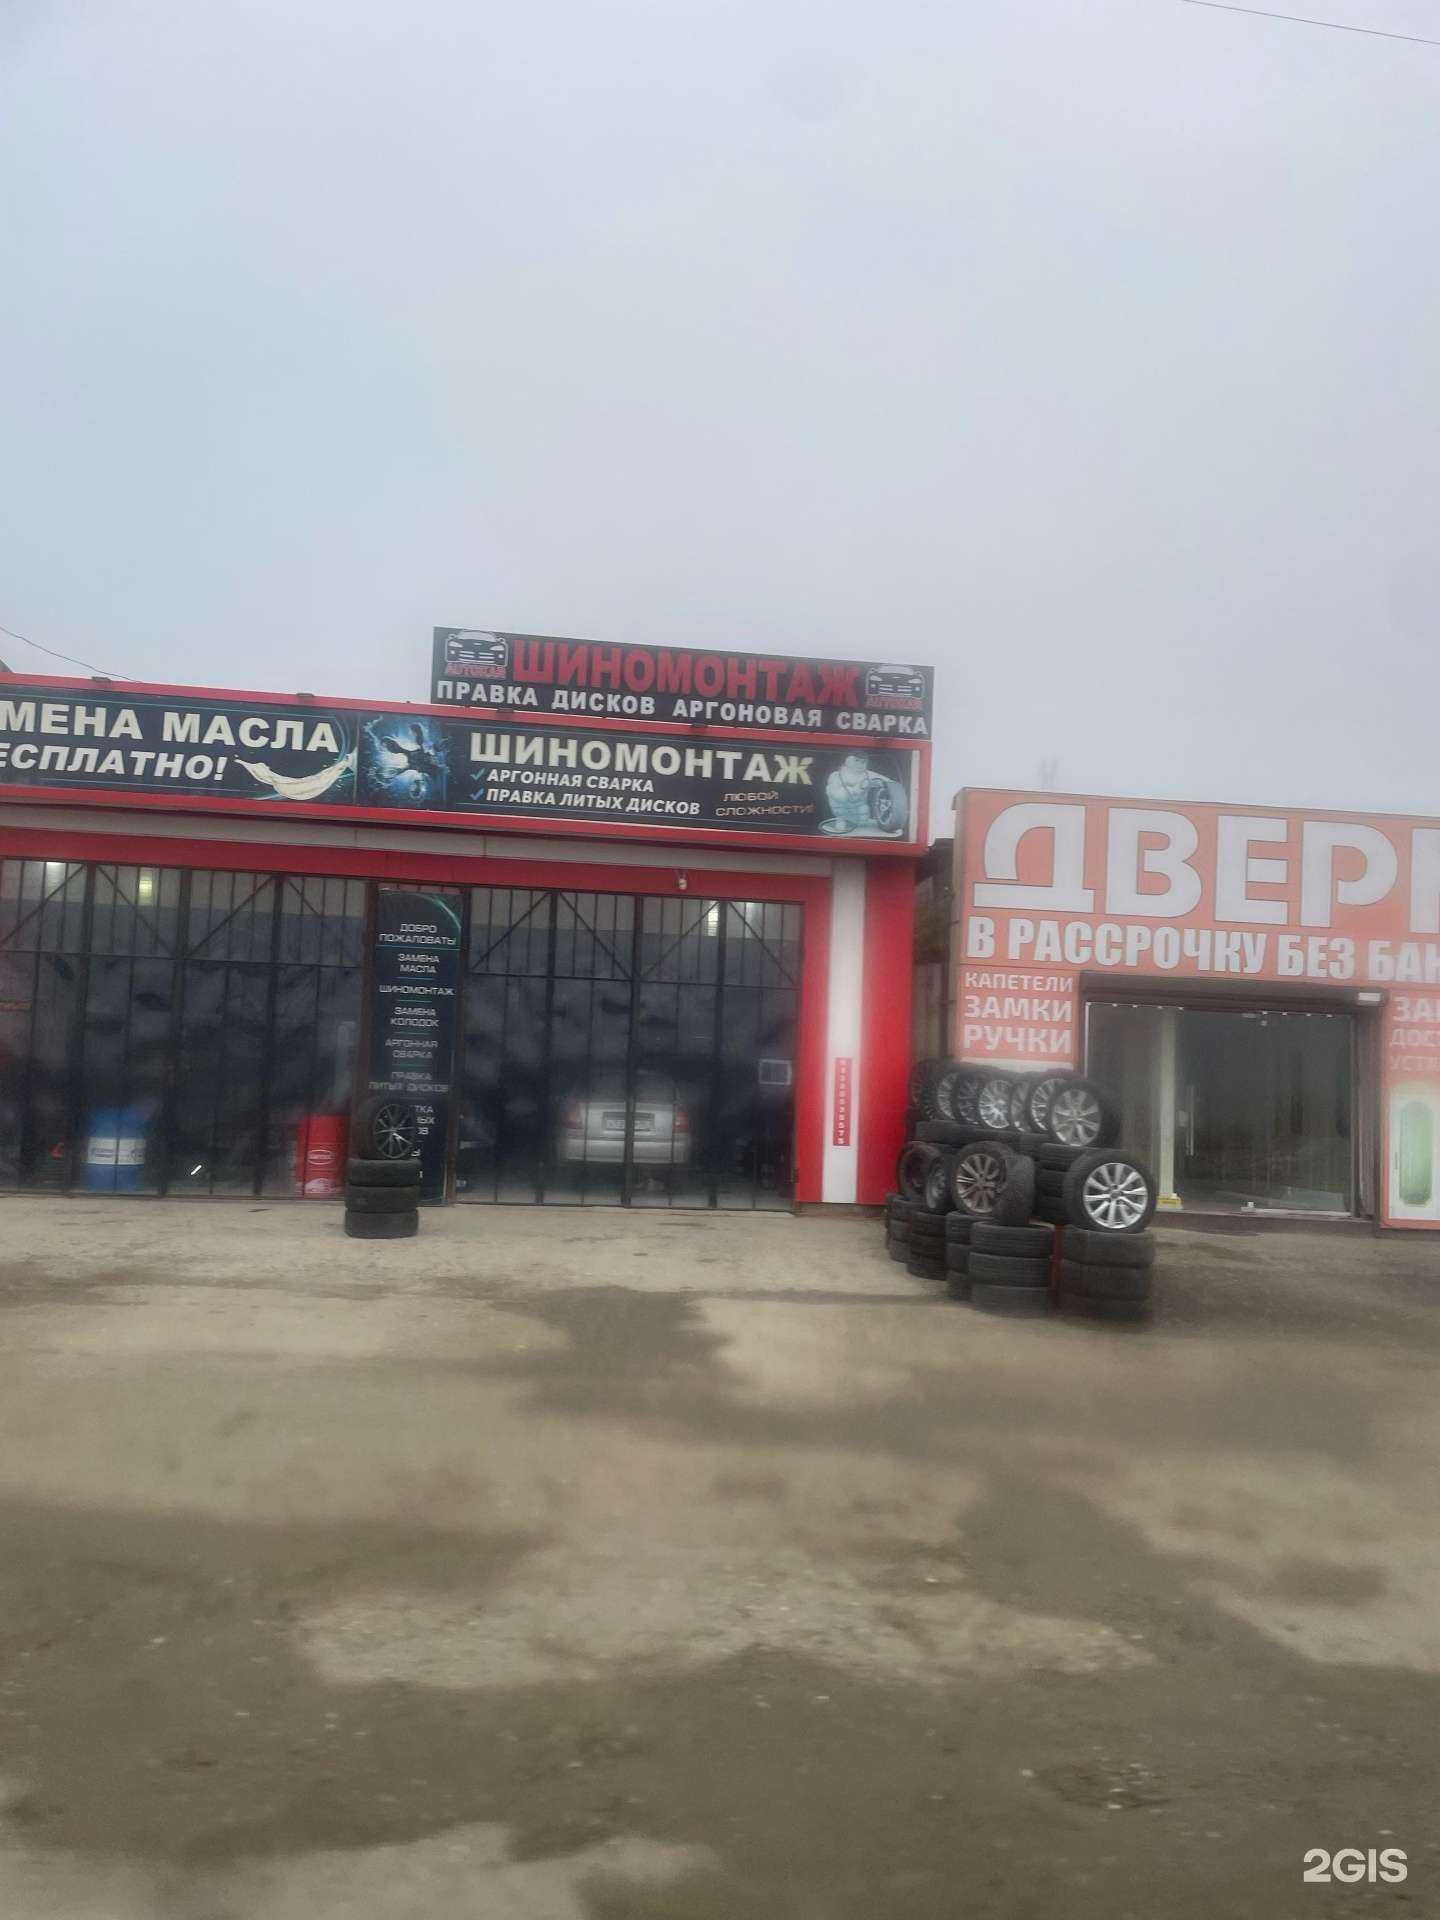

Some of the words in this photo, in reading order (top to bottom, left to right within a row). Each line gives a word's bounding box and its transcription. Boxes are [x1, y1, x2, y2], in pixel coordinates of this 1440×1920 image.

[513, 639, 861, 706] ШИНОМОНТАЖ
[436, 680, 539, 706] ПРАВКА
[551, 689, 656, 715] ДИСКОВ
[672, 698, 823, 727] АРГОНОВАЯ
[835, 711, 929, 735] СВАРКА
[162, 711, 339, 753] МАСЛА
[470, 732, 814, 786] ШИНОМОНТАЖ
[486, 768, 583, 788] АРГОННАЯ
[586, 775, 655, 793] СВАРКА
[486, 788, 557, 806] ПРАВКА
[559, 793, 623, 810] ЛИТЫХ
[625, 798, 701, 816] ДИСКОВ
[723, 790, 779, 802] ЛЮБОЙ
[400, 923, 438, 934] ДОБРО
[966, 915, 995, 959] В
[1007, 918, 1267, 974] РАССРОЧКУ
[1276, 934, 1355, 980] БЕЗ
[964, 971, 1073, 993] КАПЕТЕЛИ
[964, 995, 1073, 1023] ЗАМКИ
[1392, 996, 1440, 1025] ЗА
[963, 1023, 1072, 1055] РУЧКИ
